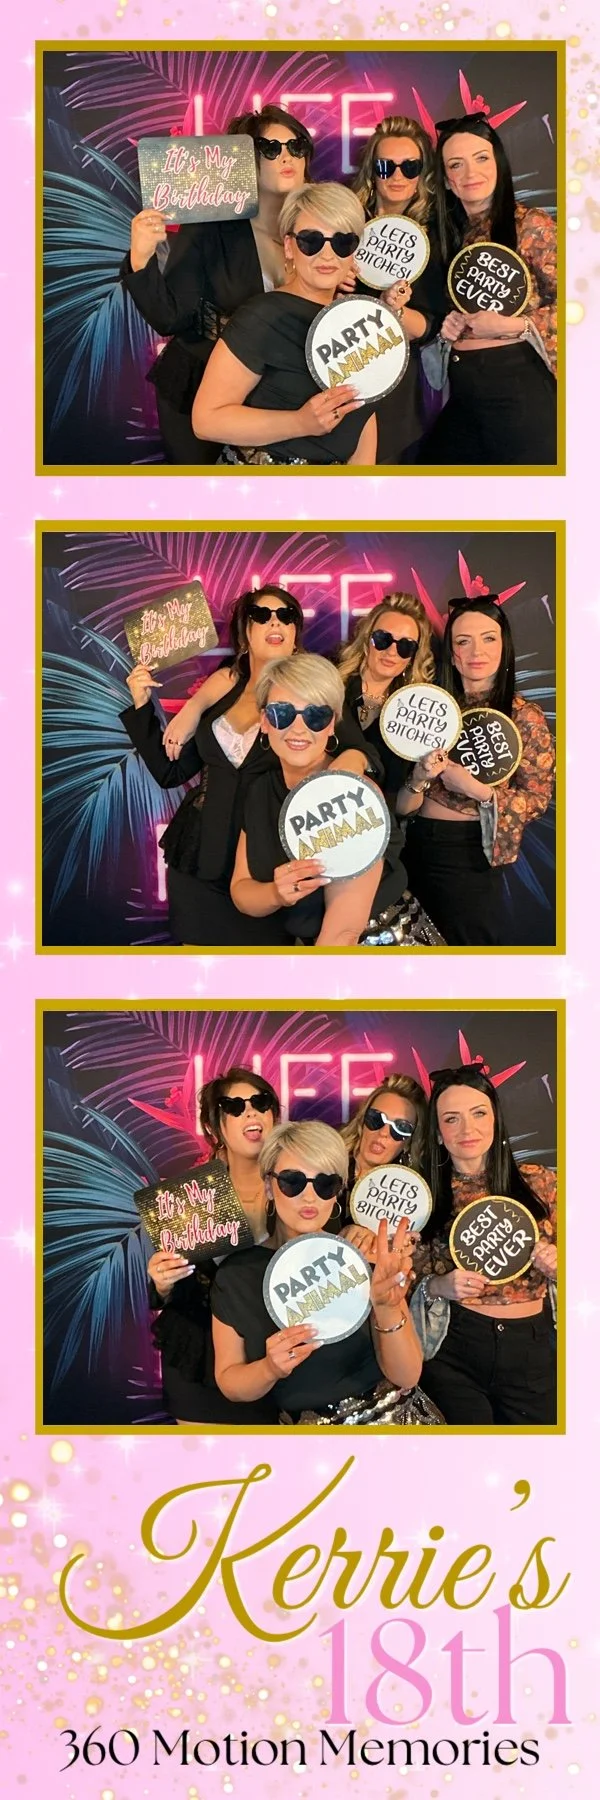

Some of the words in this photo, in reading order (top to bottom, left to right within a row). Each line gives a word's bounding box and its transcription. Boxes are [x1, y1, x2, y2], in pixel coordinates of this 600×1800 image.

[163, 146, 200, 174] It's
[205, 145, 237, 178] My
[152, 175, 250, 213] Birthday
[366, 235, 415, 263] PARTY
[380, 224, 417, 248] LETS
[355, 248, 411, 279] BITCHES!
[467, 266, 511, 298] PARTY
[477, 252, 520, 283] BEST
[456, 277, 504, 313] EVER
[316, 309, 385, 365] PARTY
[322, 326, 403, 388] ANIMAL
[140, 610, 165, 635] It's
[166, 598, 192, 622] My
[139, 624, 209, 665] Birthday
[396, 706, 448, 733] PARTY
[408, 693, 448, 717] LETS
[386, 720, 446, 749] BITCHES!
[469, 726, 495, 768] PARTY
[486, 721, 513, 759] BEST
[289, 786, 364, 836] PARTY
[298, 806, 384, 860] ANIMAL
[155, 1191, 186, 1221] It's
[184, 1179, 216, 1212] My
[366, 1187, 418, 1215] PARTY
[380, 1174, 418, 1199] LETS
[160, 1215, 240, 1253] Birthday
[460, 1205, 498, 1246] BEST
[473, 1218, 512, 1261] PARTY
[484, 1229, 532, 1276] EVER
[273, 1246, 344, 1304] PARTY
[285, 1264, 369, 1328] ANIMAL
